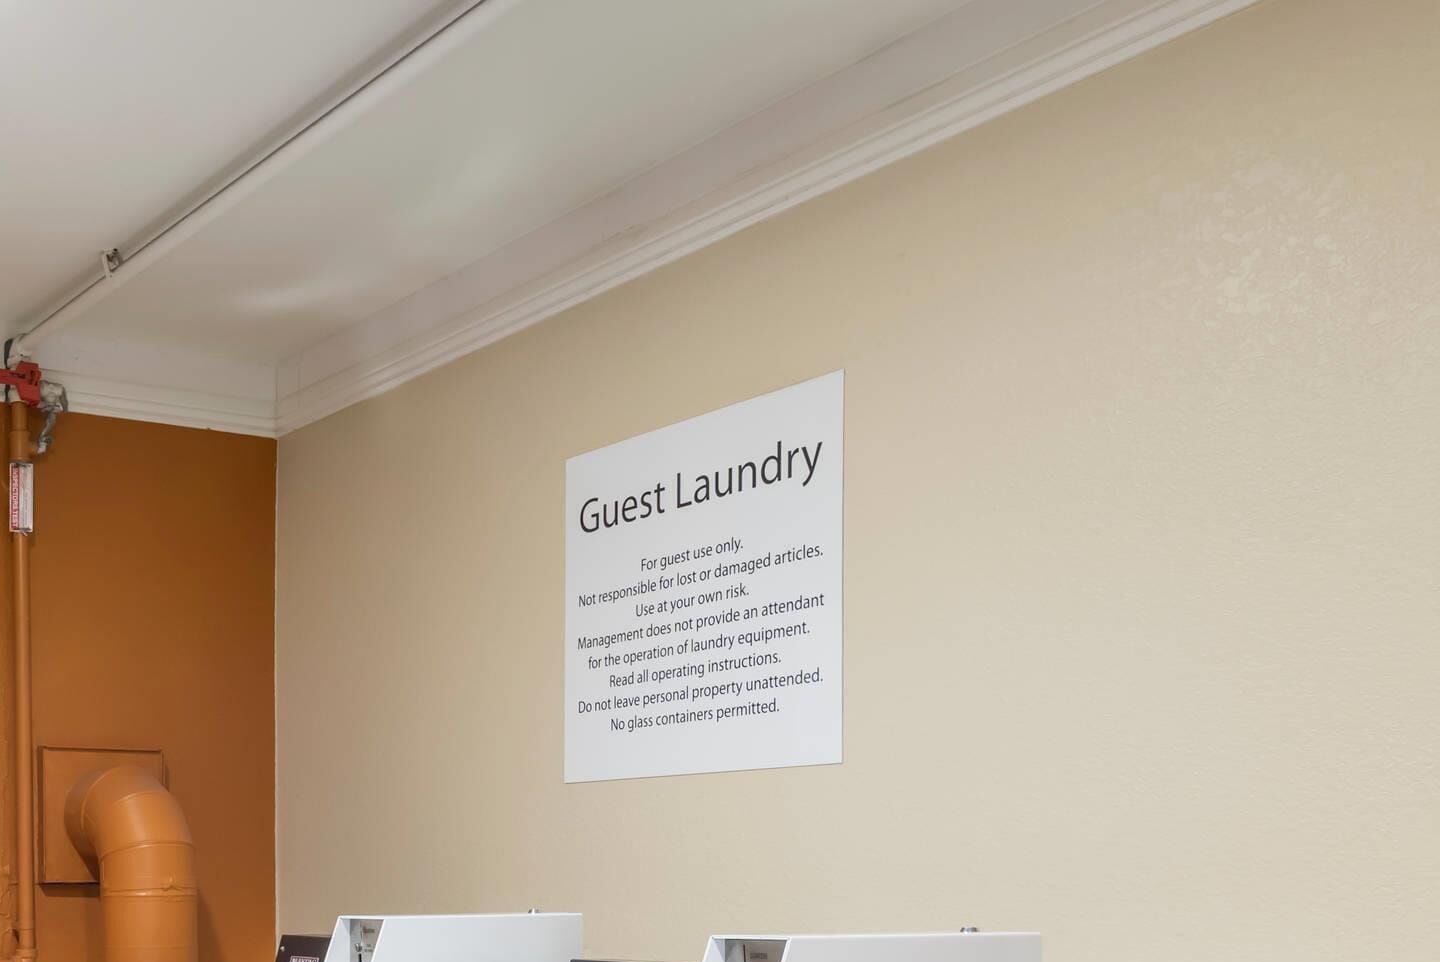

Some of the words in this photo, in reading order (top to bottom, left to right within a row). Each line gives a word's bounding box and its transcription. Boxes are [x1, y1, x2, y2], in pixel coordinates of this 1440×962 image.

[579, 481, 666, 534] Guest
[676, 439, 823, 509] Laundry
[578, 593, 596, 607] Not
[597, 578, 657, 604] responsible
[658, 575, 674, 590] for
[676, 570, 697, 586] lost
[698, 568, 712, 582] or
[713, 551, 771, 578] damaged
[773, 543, 824, 566] articles.
[640, 557, 658, 572] For
[659, 549, 690, 571] guest
[692, 545, 713, 560] use
[714, 536, 744, 554] only.
[577, 627, 644, 650] Management
[645, 623, 672, 638] does
[673, 618, 693, 633] not
[695, 607, 741, 632] provide
[742, 607, 758, 620] an
[760, 593, 825, 617] attendant
[635, 603, 655, 617] Use
[656, 600, 668, 613] at
[669, 595, 696, 614] your
[697, 590, 723, 605] own
[725, 582, 750, 600] risk.
[587, 655, 602, 669] for
[603, 652, 621, 667] the
[622, 645, 674, 666] operation
[676, 638, 689, 655] of
[690, 633, 735, 652] laundry
[737, 621, 810, 647] equipment.
[577, 700, 593, 714] Do
[594, 698, 611, 712] not
[613, 695, 640, 709] leave
[642, 685, 689, 708] personal
[691, 681, 743, 702] property
[745, 666, 823, 692] unattended.
[609, 670, 635, 688] Read
[636, 668, 649, 684] all
[651, 663, 705, 684] operating
[707, 652, 782, 673] instructions.
[610, 717, 625, 731] No
[627, 714, 653, 733] glass
[654, 708, 713, 726] containers
[716, 697, 780, 723] permitted.
